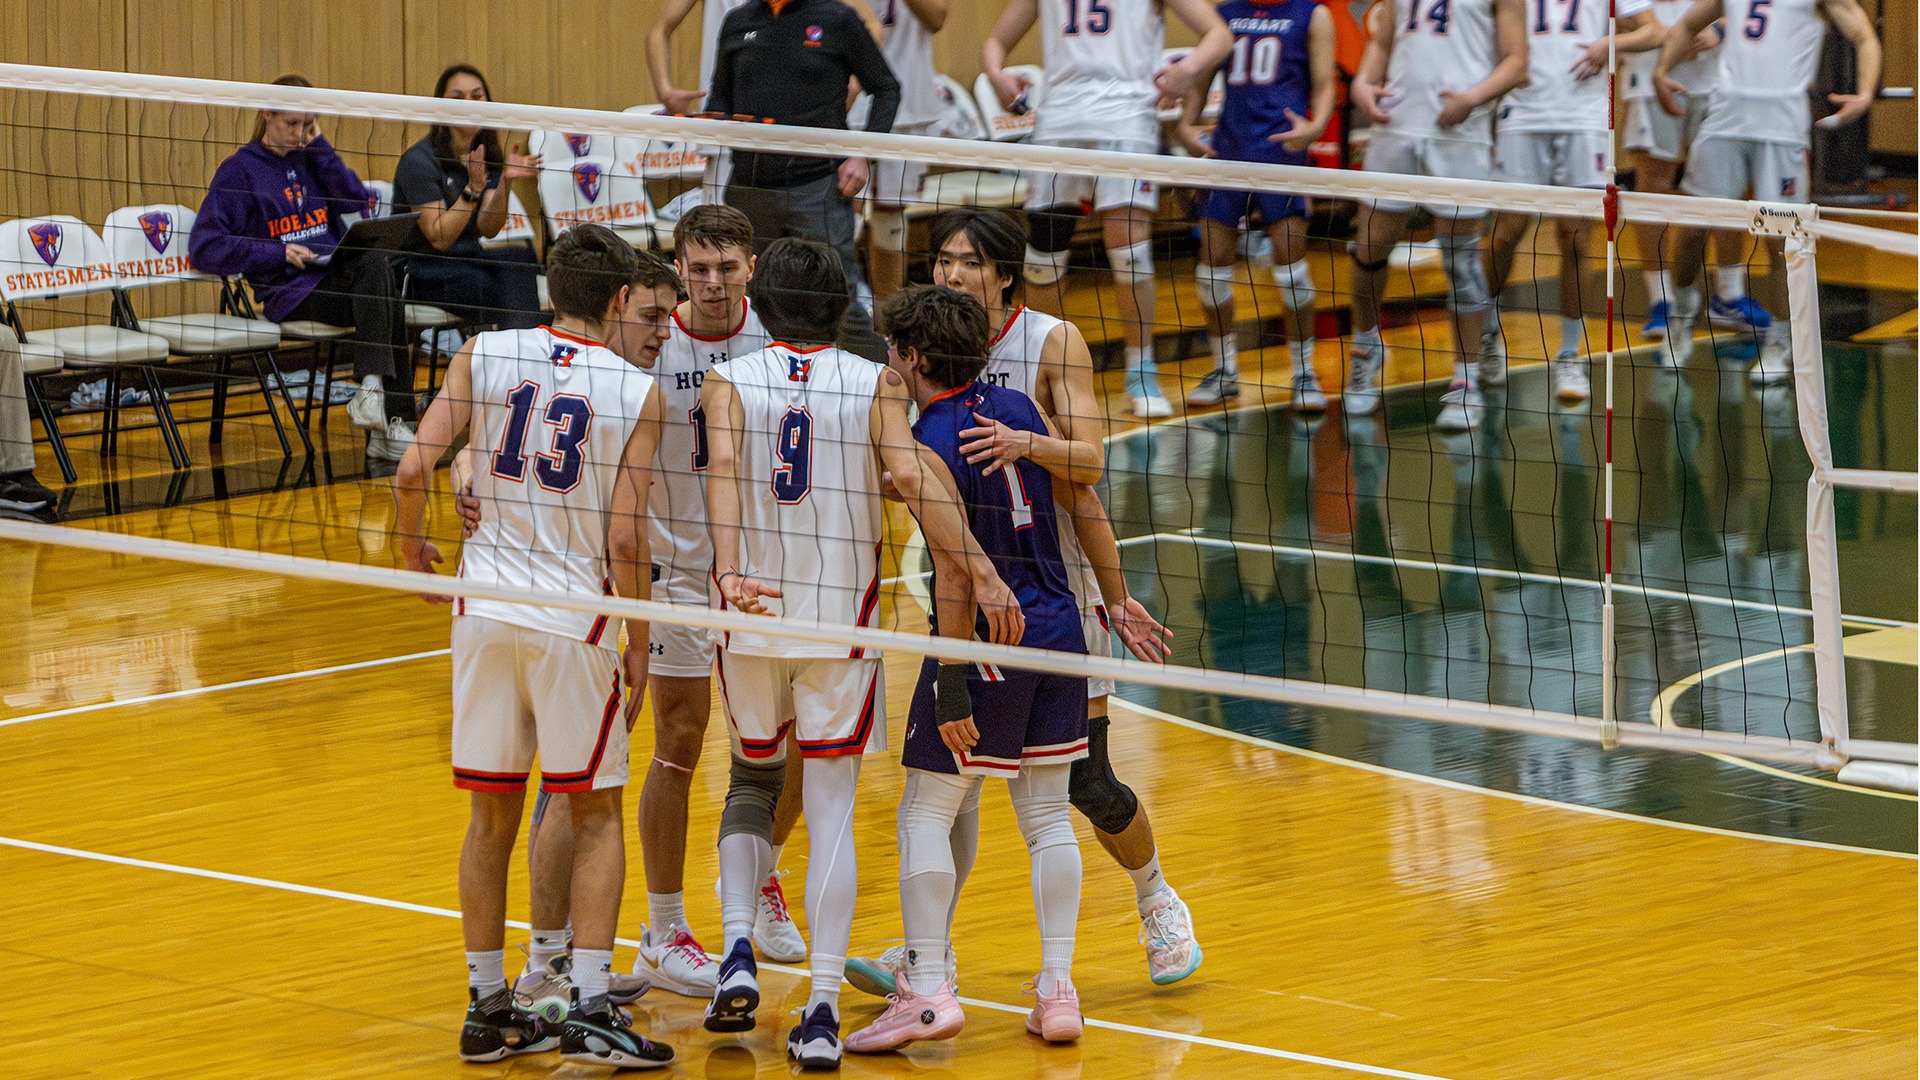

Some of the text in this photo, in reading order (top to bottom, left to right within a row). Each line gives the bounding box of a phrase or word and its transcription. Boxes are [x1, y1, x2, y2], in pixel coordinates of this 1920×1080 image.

[1062, 0, 1113, 37] 15
[1406, 0, 1449, 36] 14
[1534, 0, 1581, 34] 17
[1744, 0, 1771, 41] 5
[1226, 33, 1282, 86] 10
[1768, 207, 1798, 218] Senoh
[6, 262, 113, 291] STATESMEN
[490, 379, 594, 495] 13
[771, 405, 814, 505] 9
